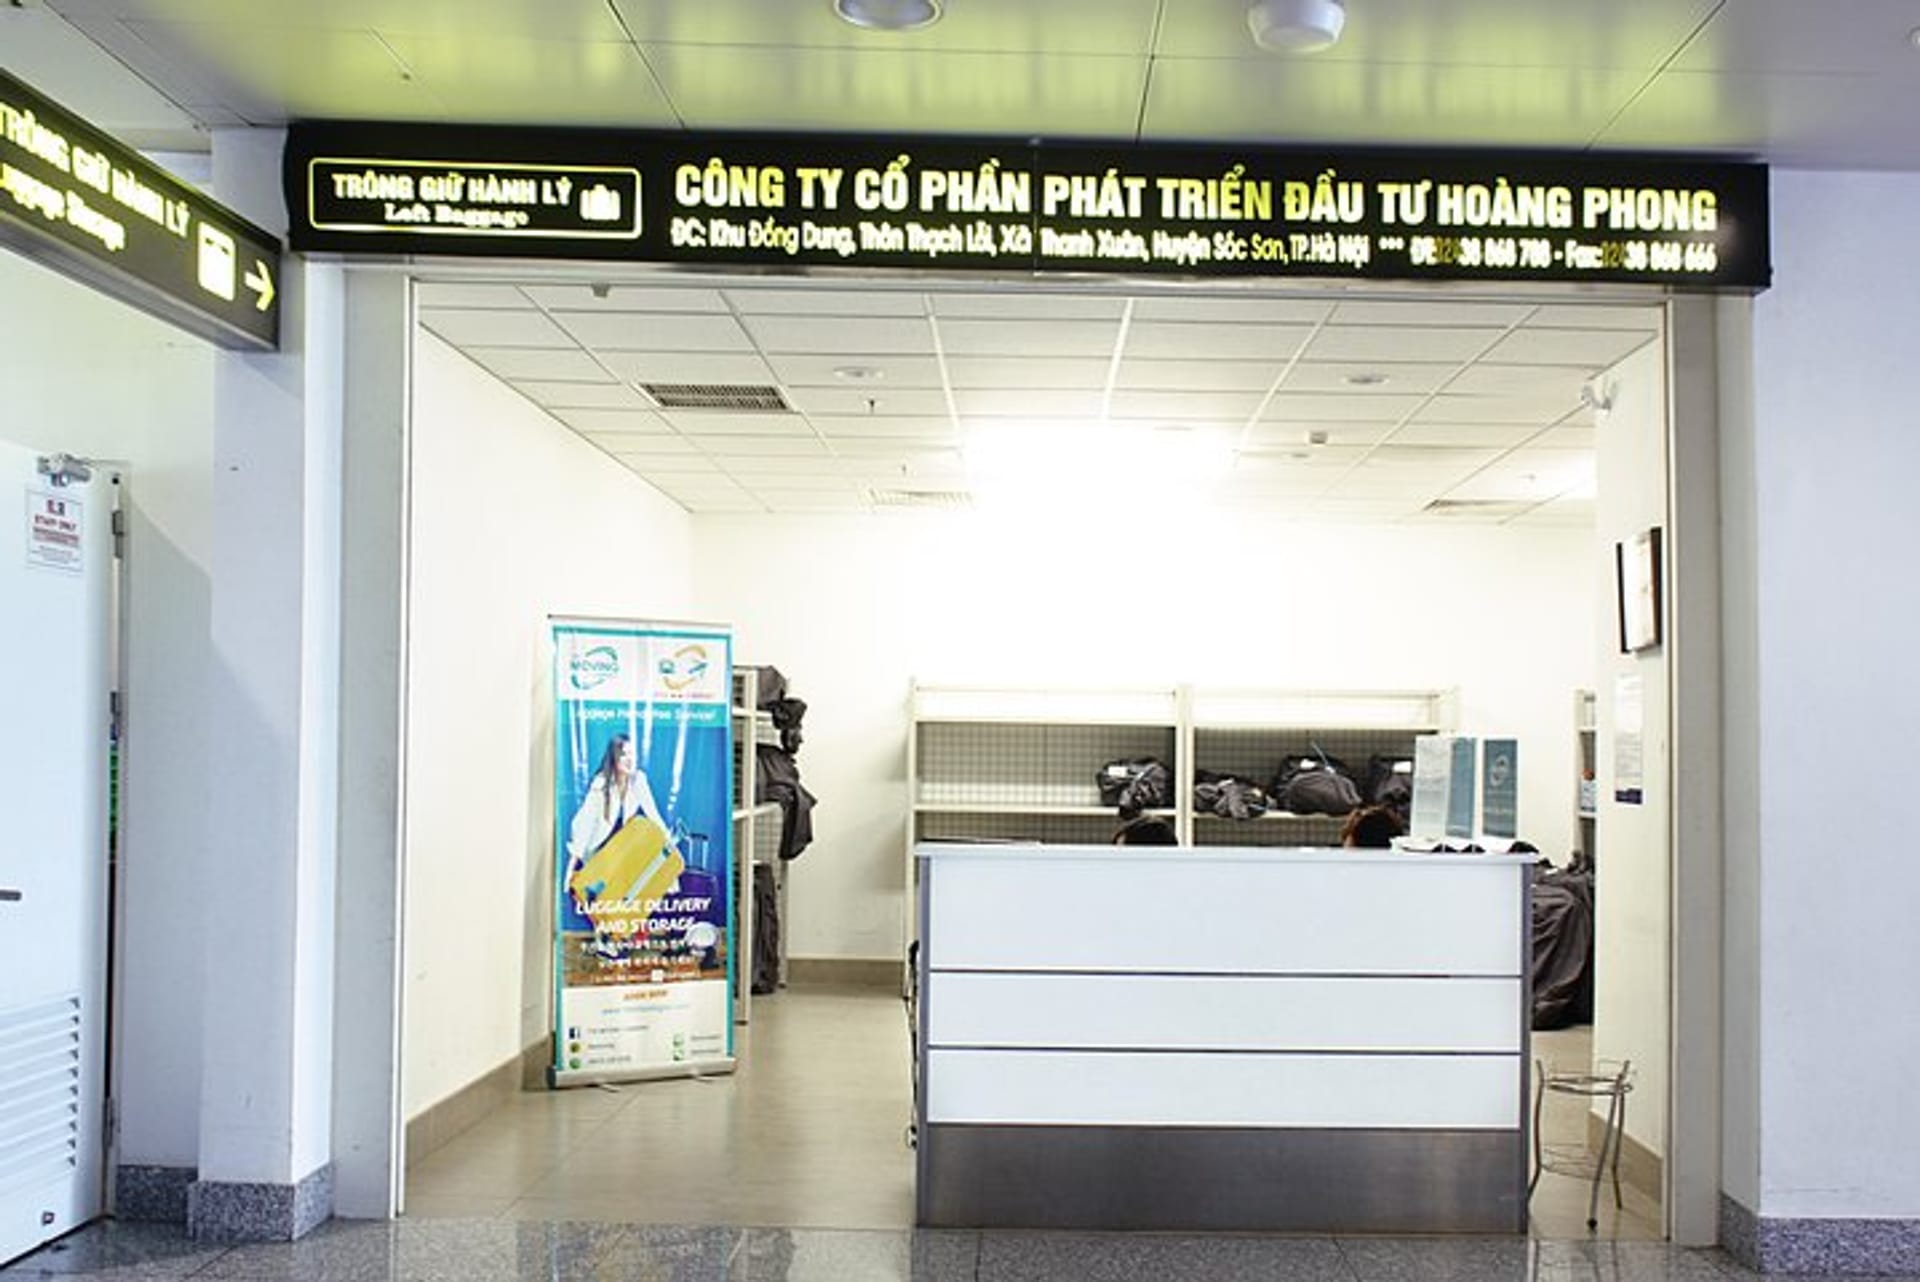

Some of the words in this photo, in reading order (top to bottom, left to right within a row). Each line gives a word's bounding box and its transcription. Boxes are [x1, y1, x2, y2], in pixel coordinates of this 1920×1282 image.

[332, 170, 414, 199] TRÔNG
[420, 172, 465, 201] GIỮ
[468, 174, 537, 204] HÀNH
[542, 177, 572, 204] LÝ
[676, 158, 784, 207] CÔNG
[797, 169, 842, 208] TY
[855, 155, 910, 210] CỔ
[920, 158, 1030, 212] PHẦN
[1044, 169, 1146, 217] PHÁT
[1157, 165, 1271, 219] TRIỂN
[1284, 169, 1363, 222] ĐẦU
[1378, 180, 1431, 224] TƯ
[1438, 178, 1572, 228] HOÀNG
[1584, 188, 1718, 231] PHONG
[166, 199, 190, 238] LÝ
[643, 897, 712, 913] DELIVERY
